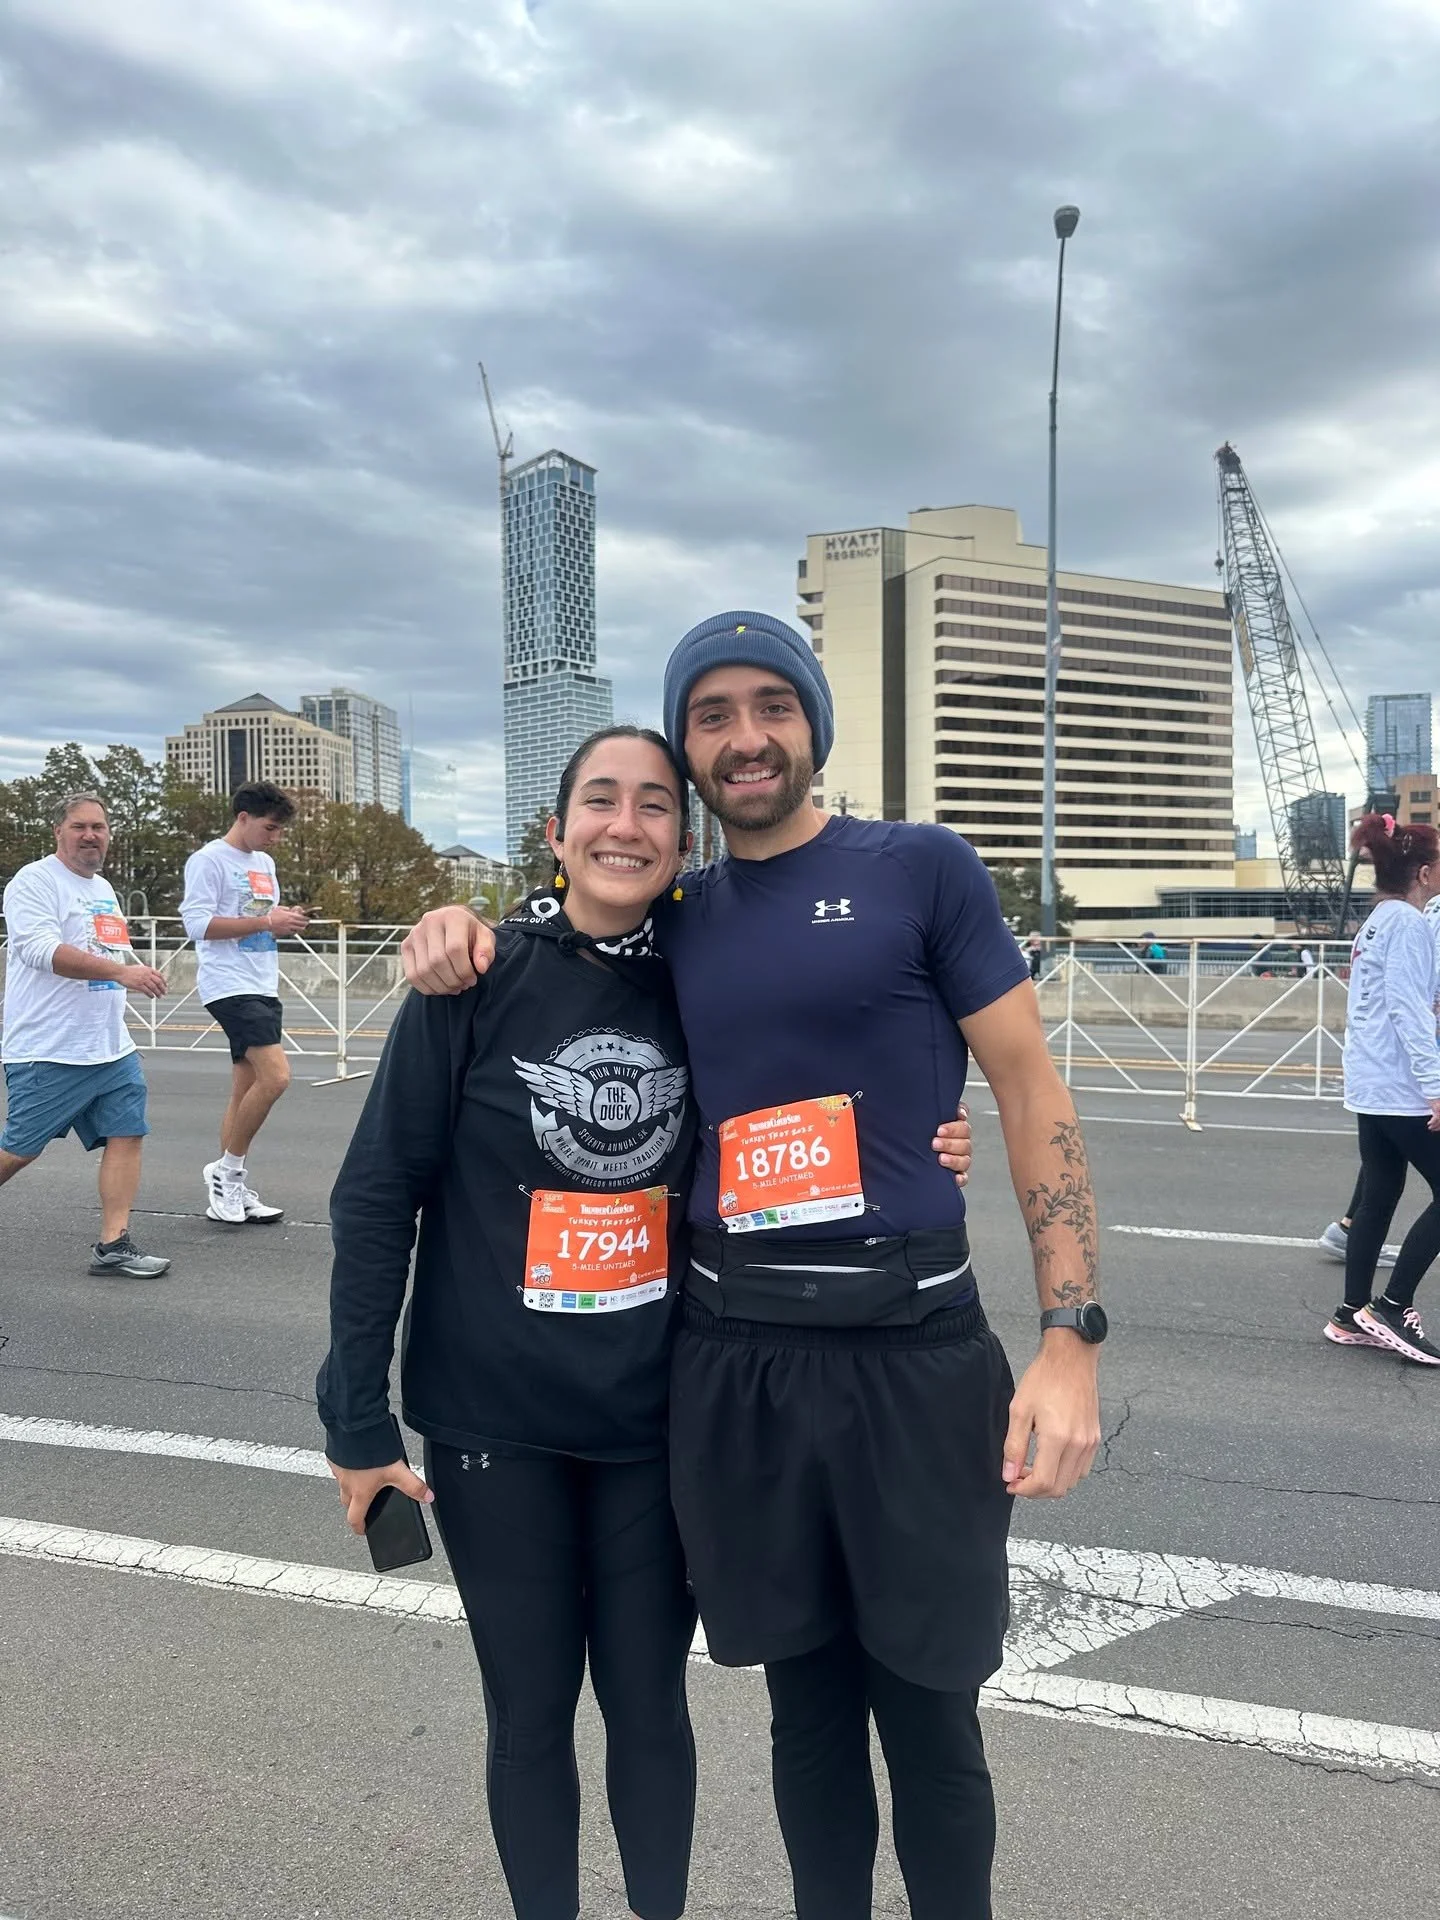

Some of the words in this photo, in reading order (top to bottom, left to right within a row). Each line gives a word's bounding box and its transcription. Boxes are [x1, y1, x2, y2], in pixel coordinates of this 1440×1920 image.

[825, 533, 880, 550] HYATT
[825, 548, 880, 560] REGENCY
[589, 1066, 610, 1081] RUN
[613, 1066, 639, 1080] WITH
[606, 1087, 627, 1103] THE
[600, 1104, 632, 1121] DUCK
[578, 1128, 606, 1152] SEVENTH
[607, 1137, 637, 1152] ANNUAL
[637, 1128, 649, 1140] 5K
[741, 1134, 766, 1145] TURKEY
[768, 1129, 790, 1140] TROT
[555, 1136, 574, 1159] WHERE
[574, 1156, 598, 1170] SPIRIT
[603, 1161, 628, 1172] MEETS
[632, 1136, 666, 1167] TRADITION
[736, 1136, 831, 1181] 18786
[581, 1177, 606, 1188] OREGON
[608, 1169, 651, 1188] HOMECOMING
[752, 1177, 777, 1190] 5-MILE
[779, 1172, 815, 1185] UNTIMED
[568, 1216, 599, 1226] TURKEY
[601, 1218, 623, 1227] TROT
[557, 1225, 650, 1261] 17944
[572, 1263, 600, 1271] 5-MILE
[603, 1260, 636, 1271] UNTIMED
